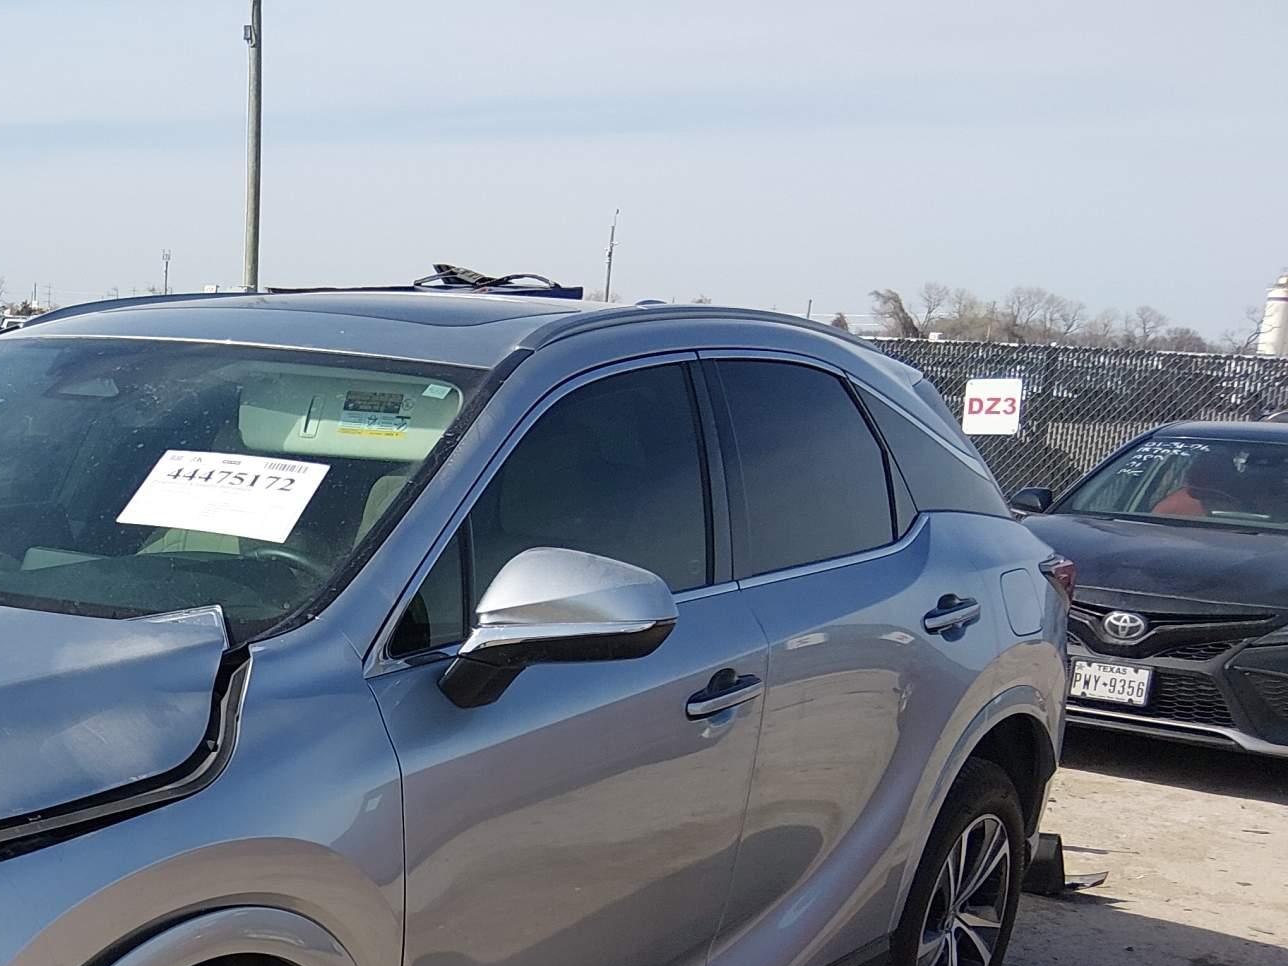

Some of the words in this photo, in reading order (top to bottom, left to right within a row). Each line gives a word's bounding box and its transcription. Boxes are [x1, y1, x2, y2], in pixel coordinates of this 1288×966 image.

[968, 397, 1017, 415] DZ3
[167, 463, 296, 492] 44475172
[1096, 664, 1129, 675] TEXAS
